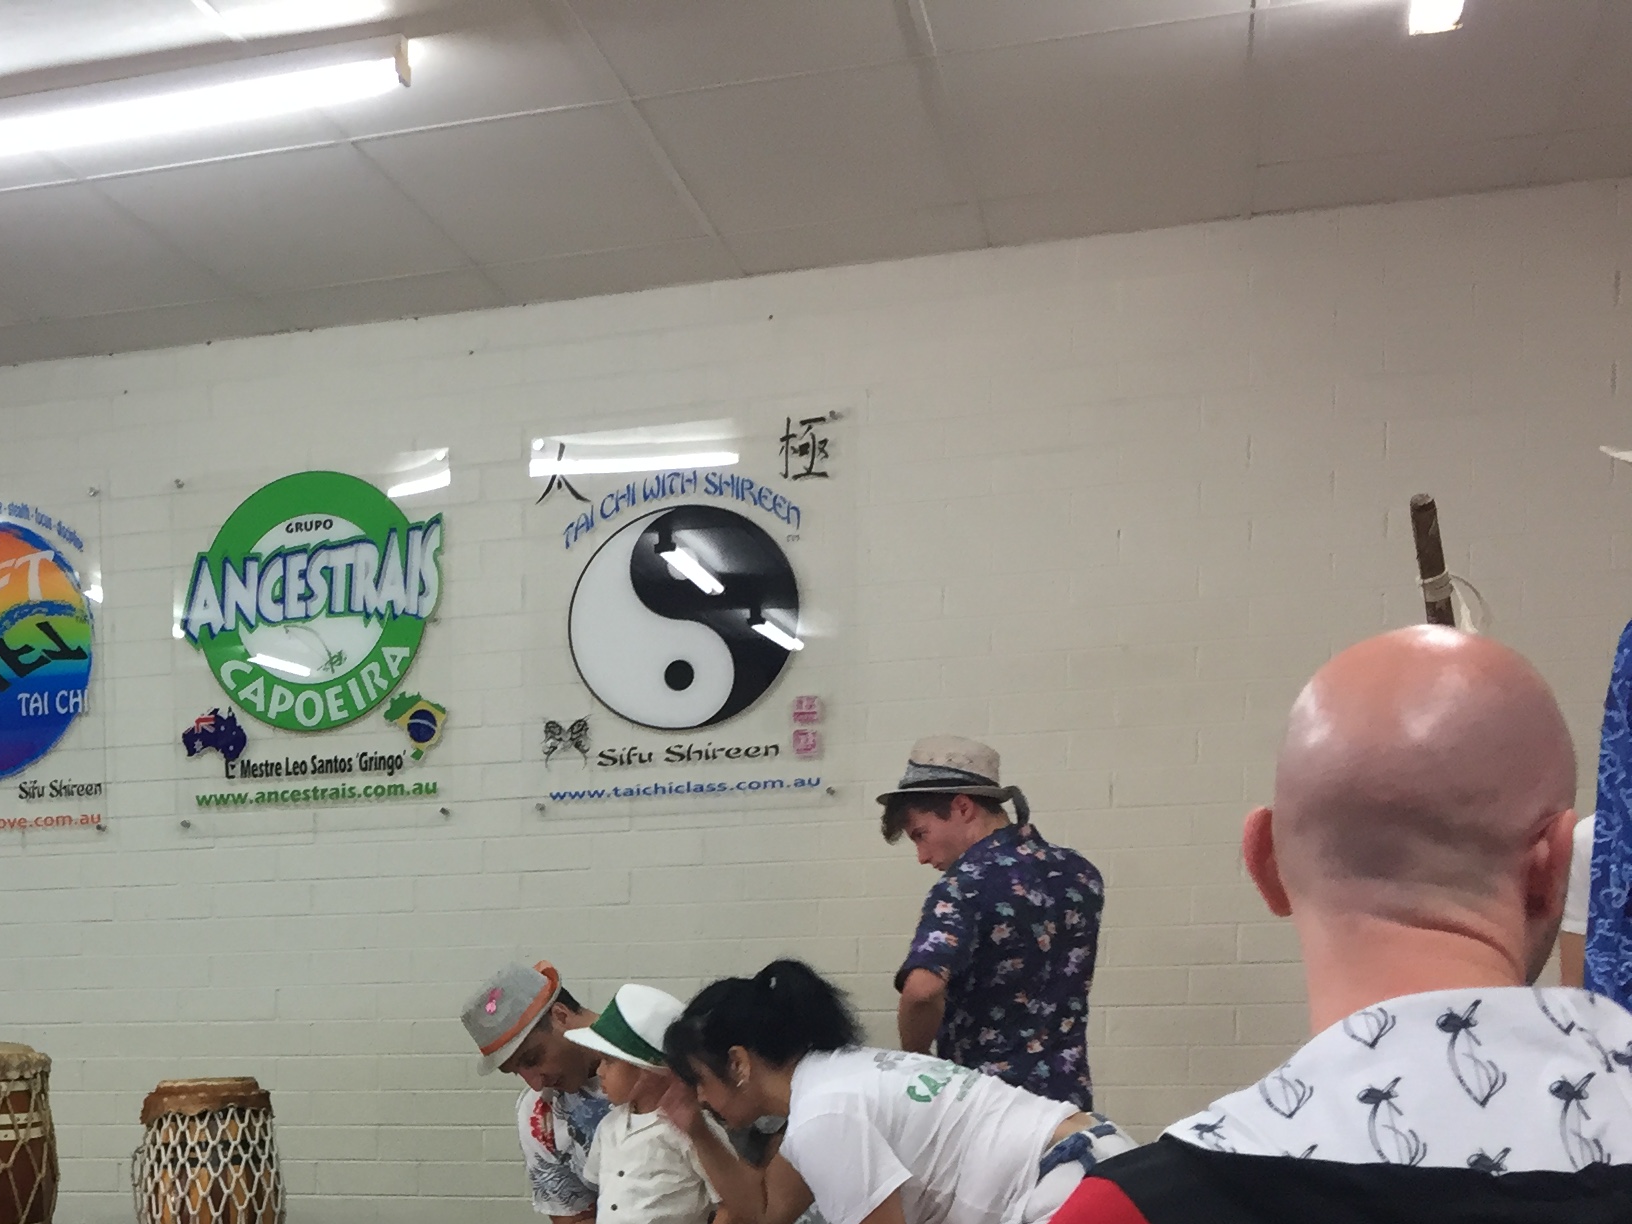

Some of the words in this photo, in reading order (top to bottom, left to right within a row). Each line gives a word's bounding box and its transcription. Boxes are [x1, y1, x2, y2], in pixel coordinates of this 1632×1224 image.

[563, 505, 594, 549] TAI
[600, 482, 636, 520] CHI
[643, 470, 697, 503] WITH
[285, 518, 334, 534] GRUPO
[184, 514, 443, 648] ANCESTRAIS
[220, 646, 410, 727] CAPOEIRA
[17, 691, 49, 716] TAI
[56, 689, 88, 714] CHI
[240, 759, 282, 779] Mestre
[285, 756, 307, 776] Leo
[311, 754, 353, 774] Santos
[597, 747, 653, 767] Sifu
[664, 742, 780, 763] Shireen
[18, 780, 45, 799] Sifu
[49, 778, 102, 798] Shireen
[195, 781, 438, 806] www.ancestrais.com.au
[550, 776, 821, 801] www.taichiclass.com.au
